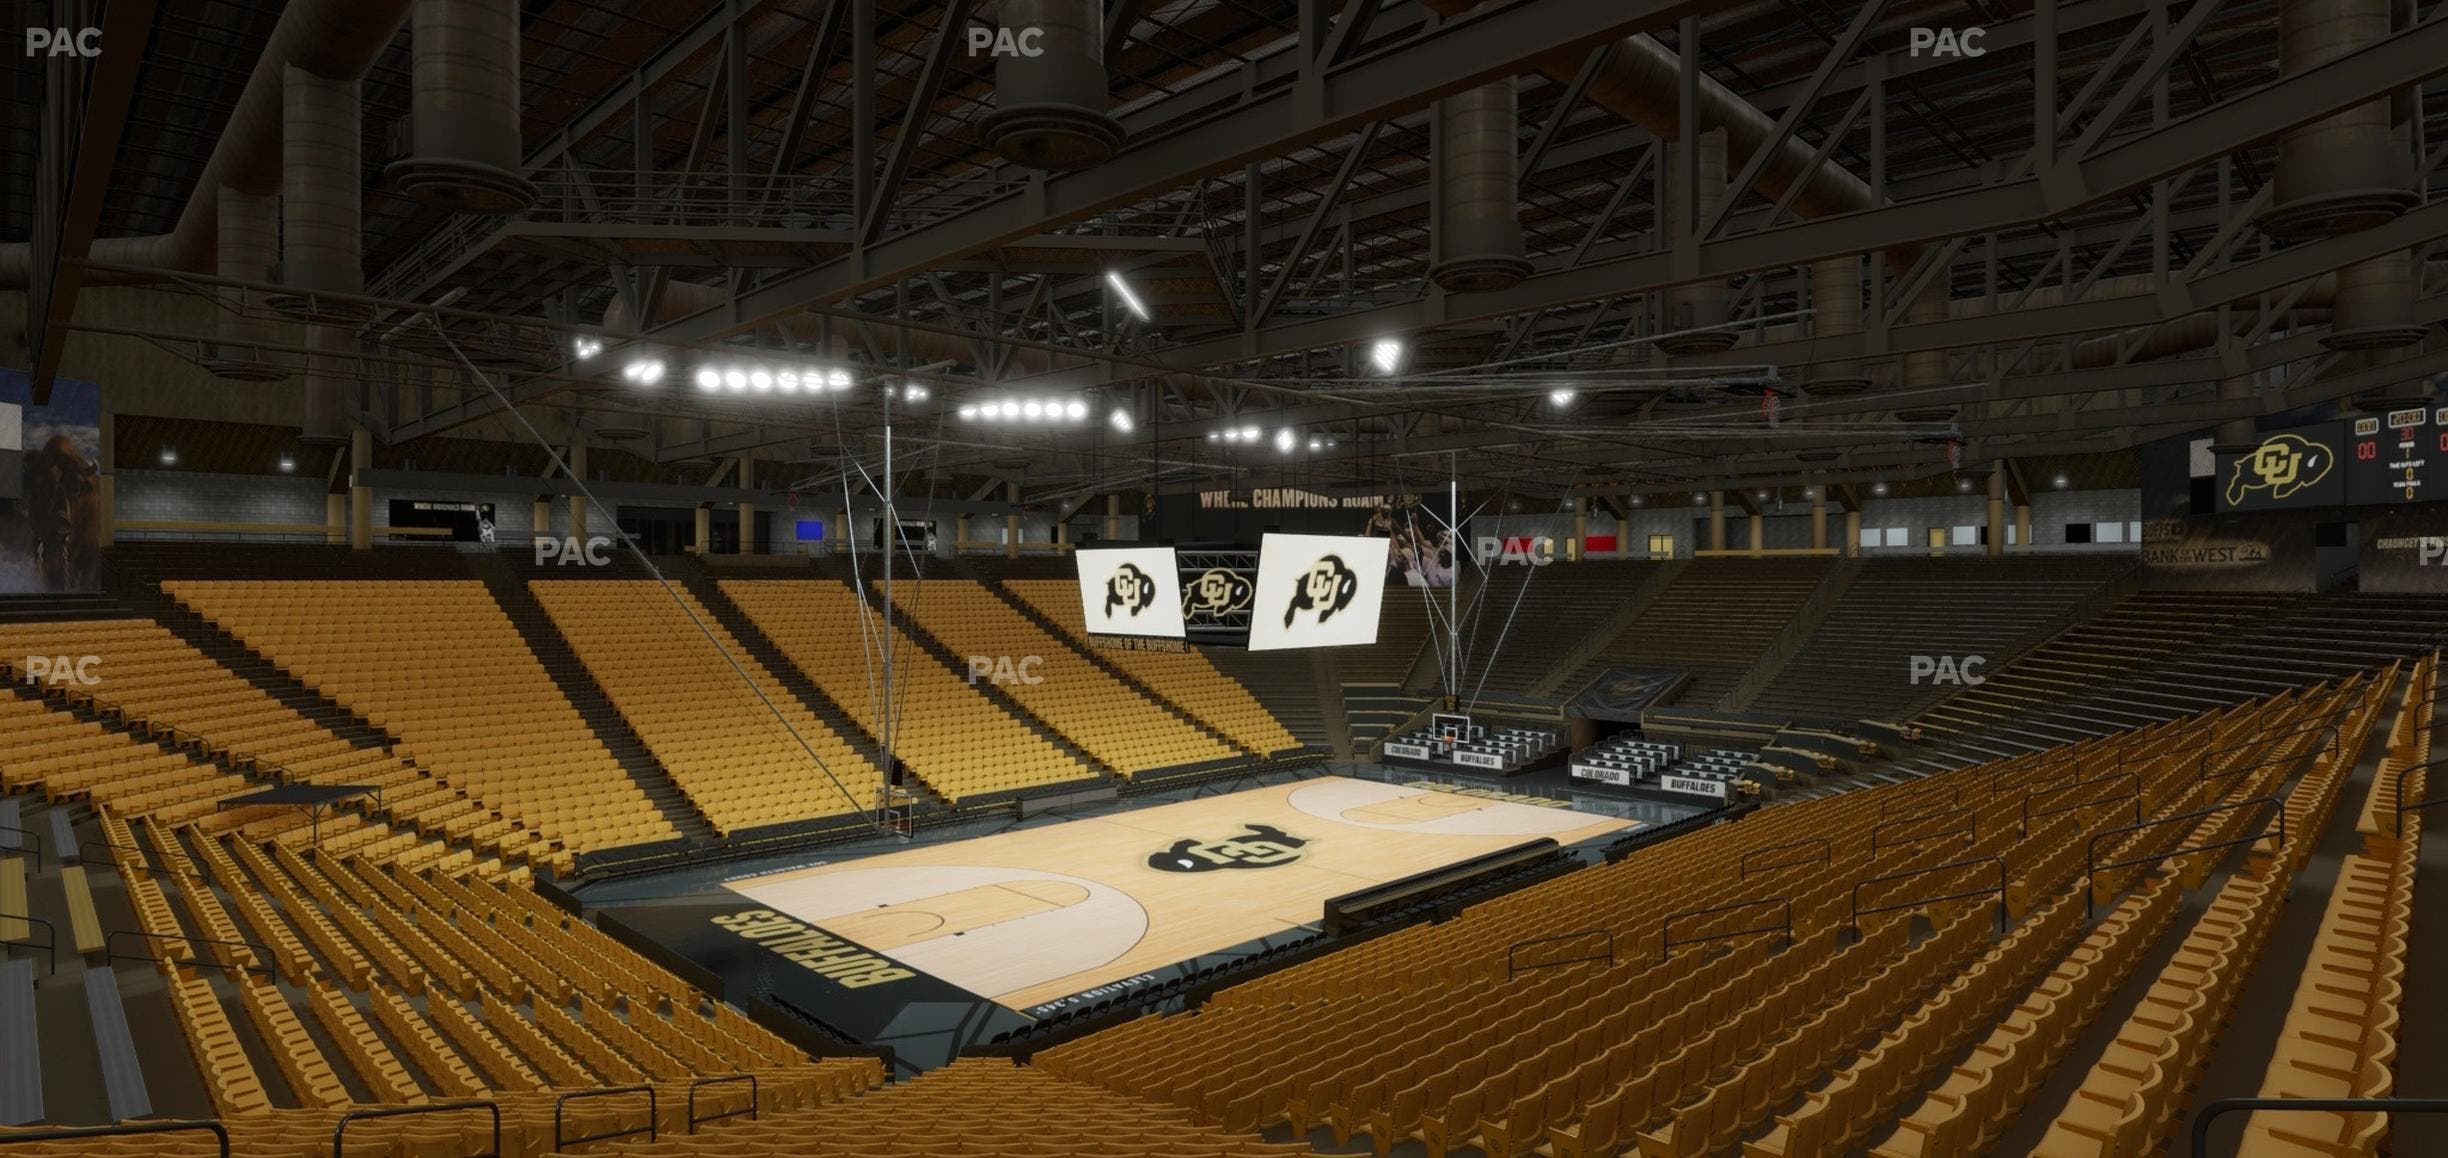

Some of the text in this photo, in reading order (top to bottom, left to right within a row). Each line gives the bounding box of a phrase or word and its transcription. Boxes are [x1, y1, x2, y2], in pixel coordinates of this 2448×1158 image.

[2192, 546, 2237, 563] WEST
[1391, 745, 1422, 757] COLORADO
[1460, 753, 1495, 766] BUFFALOES
[1580, 768, 1620, 782] COLORADO
[1670, 778, 1716, 794] BUFFALOES
[710, 909, 917, 990] BUFFALOES
[1081, 973, 1156, 999] ELEVATION
